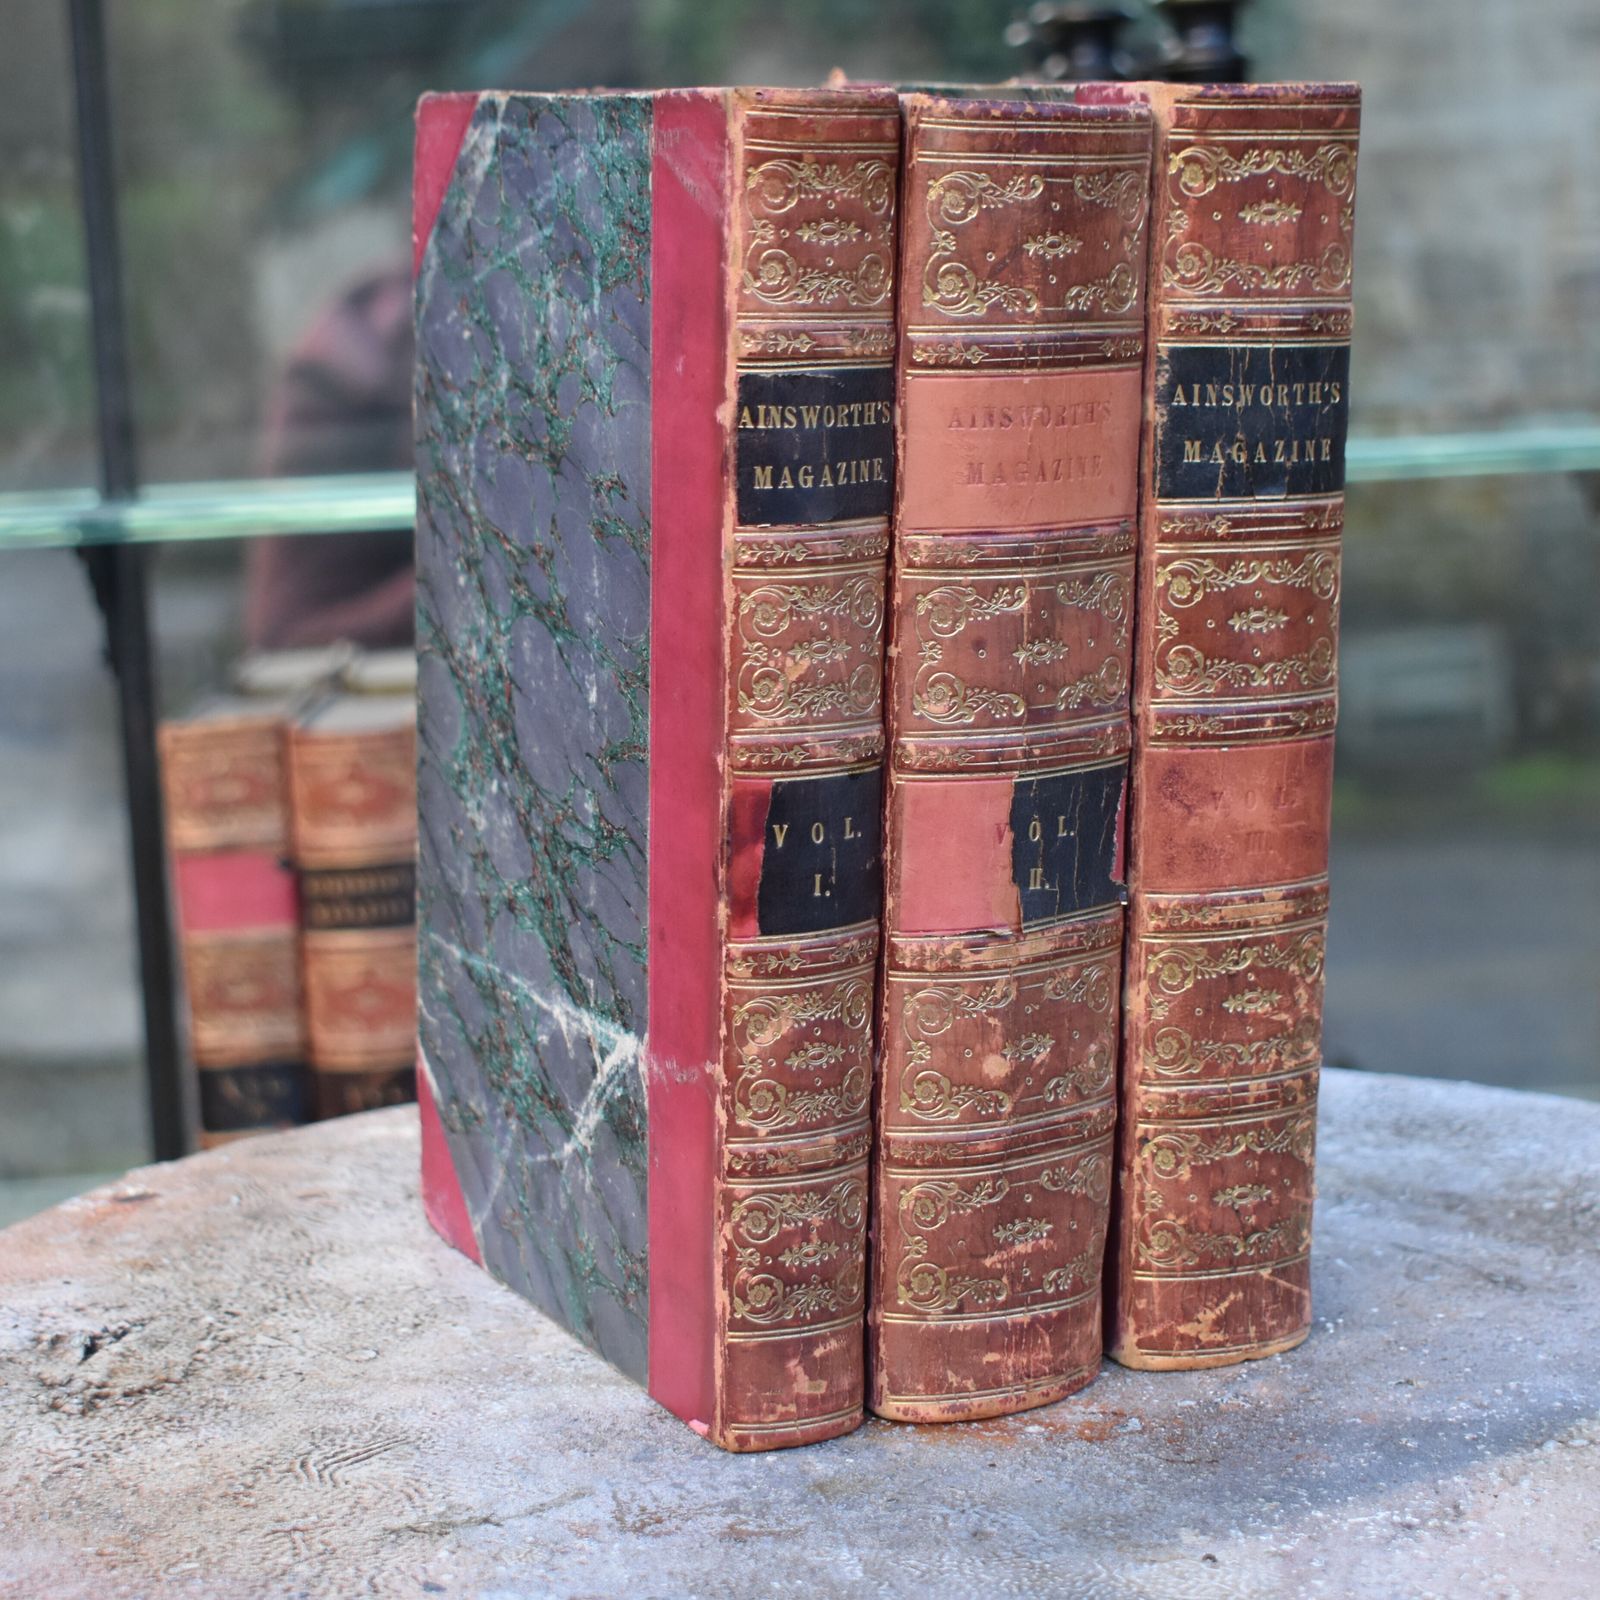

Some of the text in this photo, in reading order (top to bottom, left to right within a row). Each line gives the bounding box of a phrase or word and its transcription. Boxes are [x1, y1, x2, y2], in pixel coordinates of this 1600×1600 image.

[1172, 382, 1341, 407] AINSWORTH'S
[739, 402, 891, 430] AINSWORTH'S
[772, 816, 862, 849] VOL.
[814, 873, 831, 898] I.
